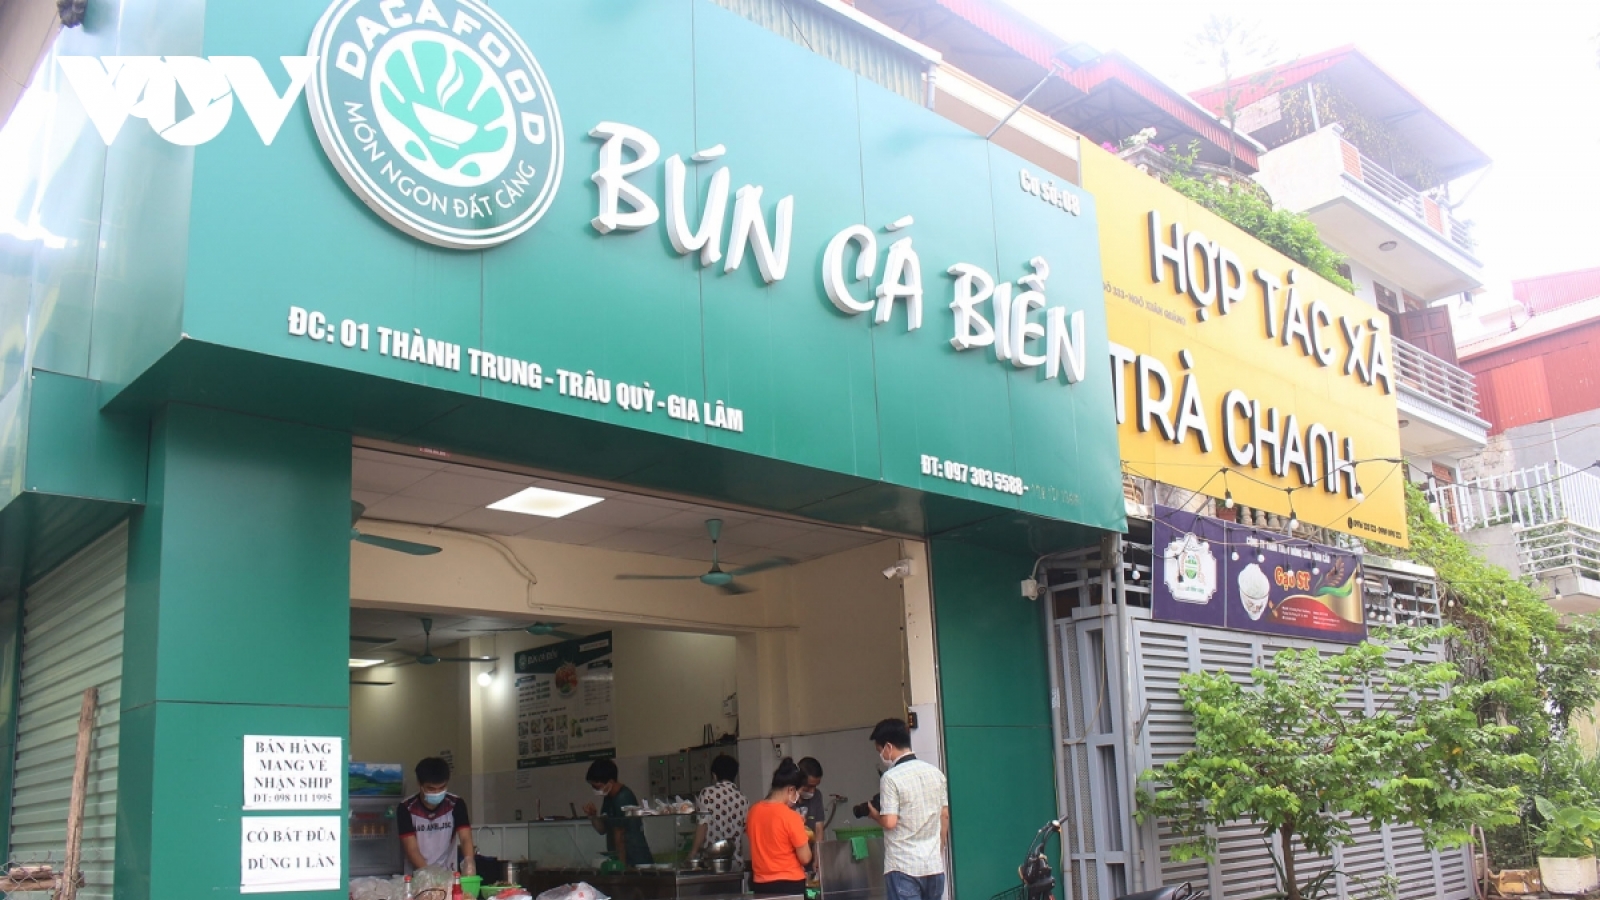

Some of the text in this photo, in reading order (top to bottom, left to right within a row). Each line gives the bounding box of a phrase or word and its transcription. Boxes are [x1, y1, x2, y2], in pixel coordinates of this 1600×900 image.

[336, 0, 545, 144] DACAFOOD
[345, 101, 386, 162] MÓN
[380, 160, 447, 215] NGON
[453, 193, 493, 219] ĐẤT
[588, 121, 1085, 384] BÚN CÁ BIỂN
[1148, 209, 1391, 395] HỢP TÁC XÃ
[288, 305, 334, 343] ĐC:
[340, 319, 369, 351] 01
[377, 327, 461, 372] THÀNH
[703, 400, 743, 433] LÂM
[1108, 341, 1359, 500] TRÀ CHANH
[921, 454, 943, 478] ĐT:
[944, 459, 968, 484] 097
[969, 466, 993, 489] 303
[1275, 566, 1311, 591] Gạo ST
[256, 739, 332, 754] BÁN HÀNG
[260, 759, 304, 771] MANG
[274, 793, 290, 803] 098
[294, 793, 308, 803] 111
[312, 793, 333, 803] 1995
[300, 777, 333, 789] SHIP
[247, 827, 336, 843] CÓ BÁT ĐŨA
[248, 854, 290, 870] DÙNG
[296, 857, 301, 868] 1
